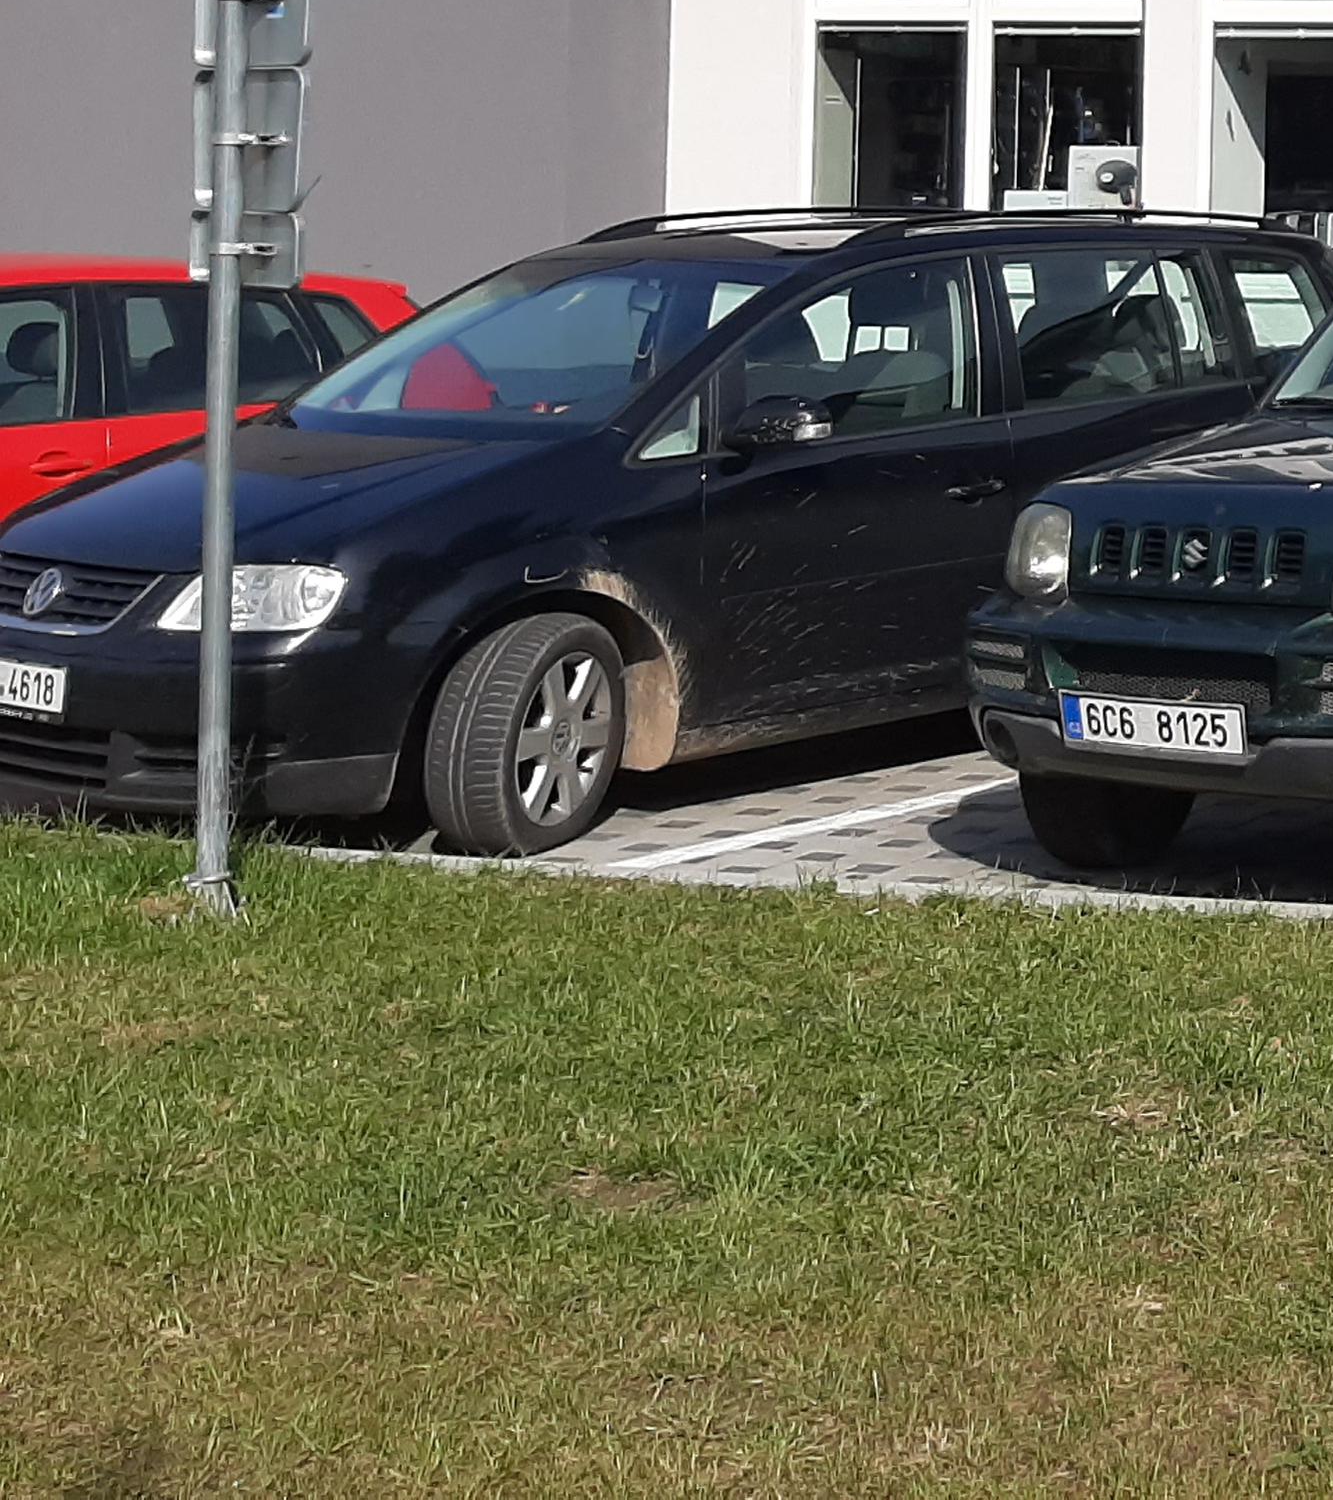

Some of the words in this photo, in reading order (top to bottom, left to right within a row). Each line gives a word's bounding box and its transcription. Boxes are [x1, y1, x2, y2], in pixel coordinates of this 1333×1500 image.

[8, 668, 54, 706] 4618
[1086, 703, 1135, 739] 6C6
[1156, 710, 1228, 748] 8125
